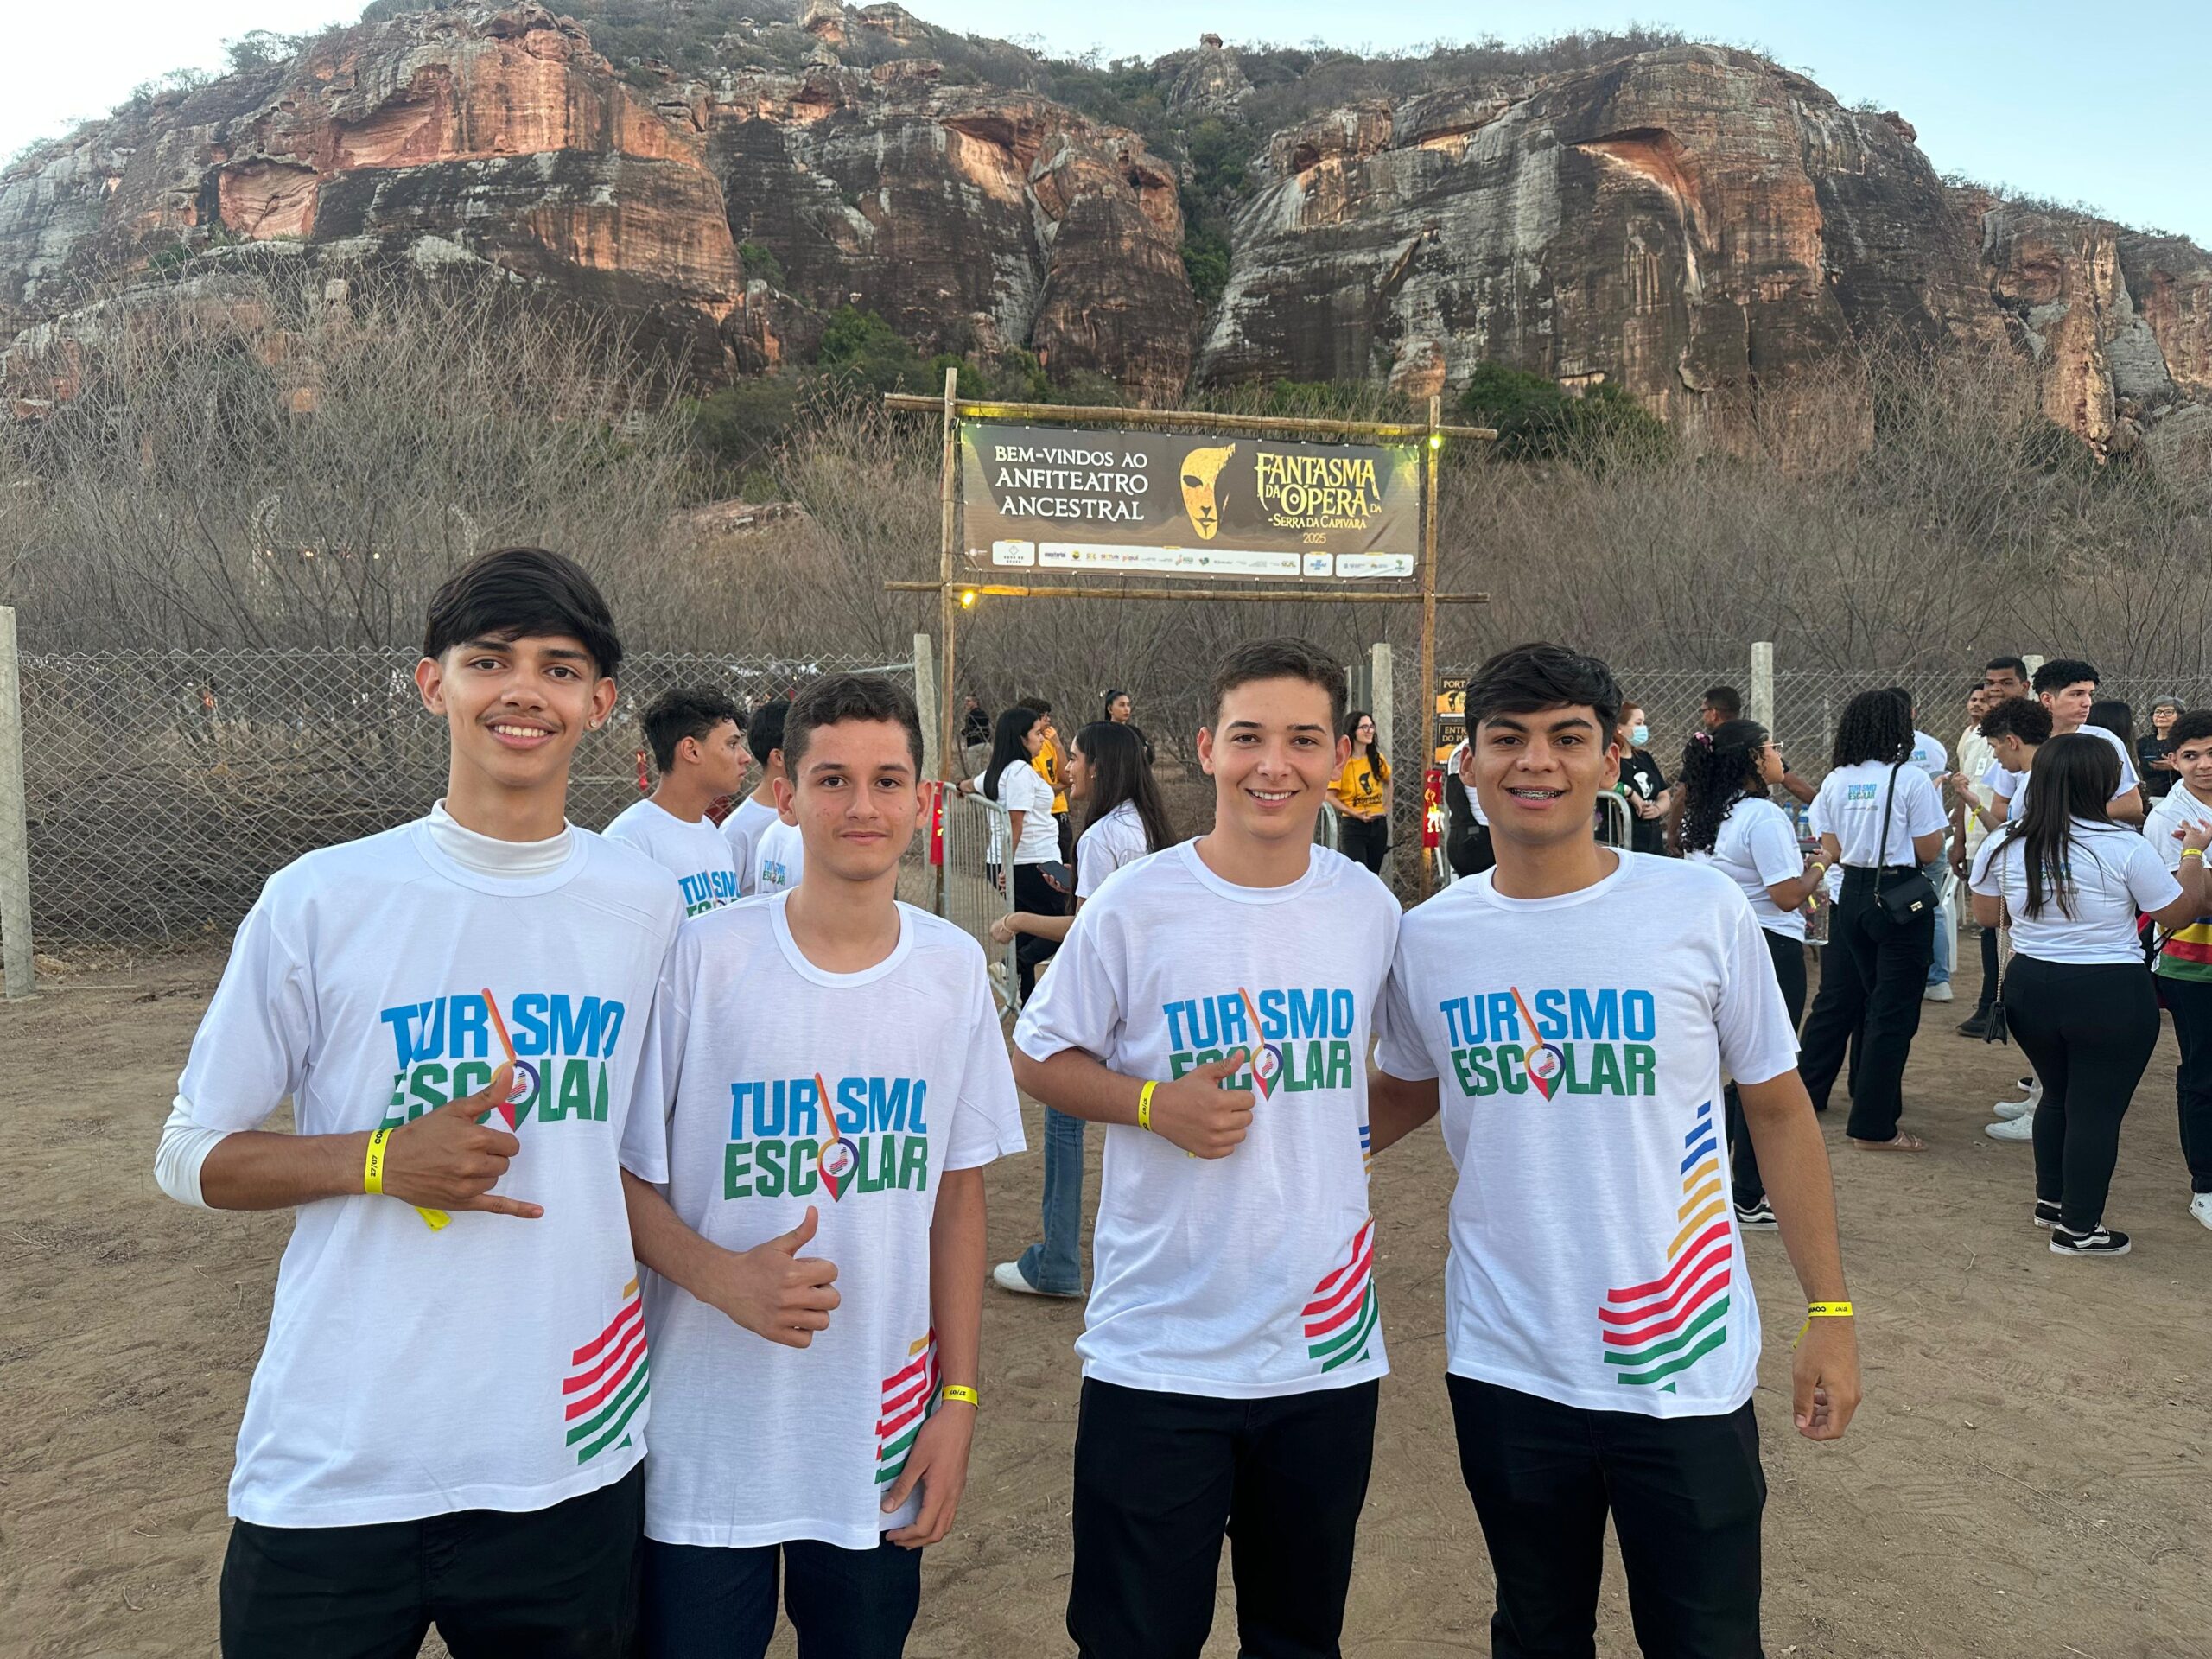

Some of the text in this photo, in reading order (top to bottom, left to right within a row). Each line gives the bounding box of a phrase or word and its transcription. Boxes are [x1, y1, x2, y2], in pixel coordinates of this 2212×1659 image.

[995, 445, 1148, 468] BEM-VINDOS AO
[995, 467, 1149, 496] ANFITEATRO
[1254, 453, 1381, 511] FANTASMA
[1265, 485, 1281, 498] DA
[999, 496, 1145, 522] ANCESTRAL
[1306, 518, 1319, 528] DA
[1320, 515, 1367, 530] CAPIVARA
[1302, 532, 1327, 544] 2025
[1443, 680, 1466, 690] PORT
[1444, 726, 1468, 735] ENTR
[380, 988, 626, 1071] TURISMO
[1162, 987, 1355, 1052] TURISMO
[1440, 986, 1656, 1048] TURISMO
[1450, 1042, 1656, 1103] ESCOLAR
[370, 1154, 378, 1177] 27/07
[724, 1134, 929, 1204] ESCOLAR
